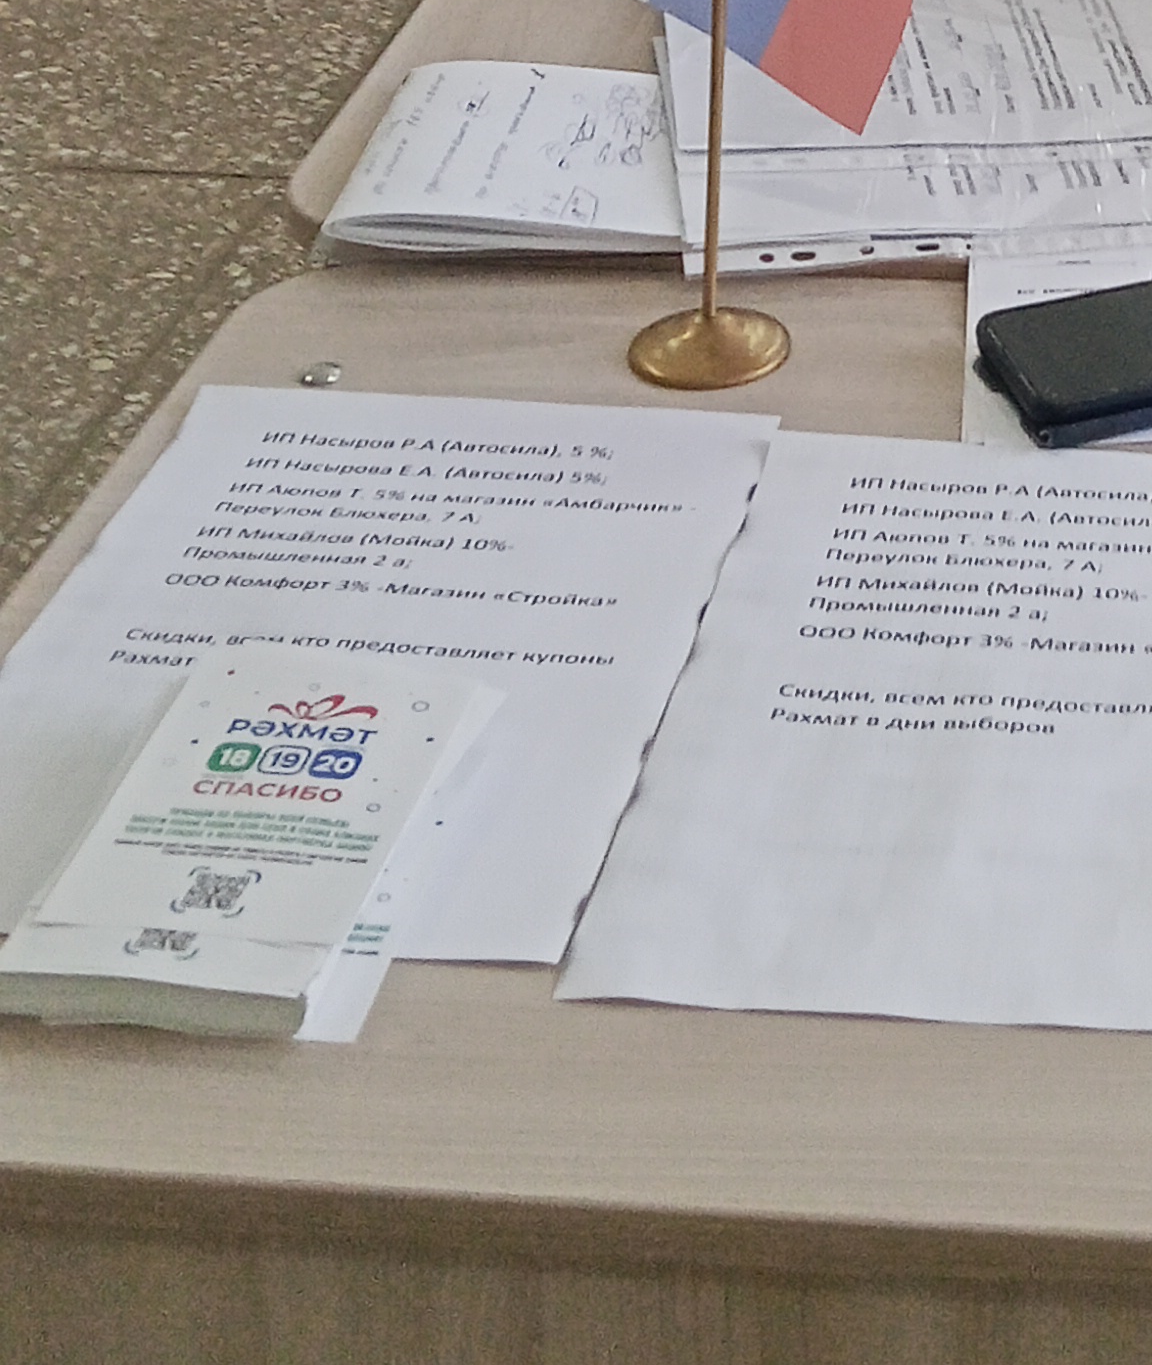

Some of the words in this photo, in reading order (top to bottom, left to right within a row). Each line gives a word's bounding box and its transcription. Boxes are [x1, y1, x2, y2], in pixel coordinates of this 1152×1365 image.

[262, 431, 296, 444] ИП
[300, 433, 395, 450] Насыров
[570, 445, 582, 458] 5
[245, 457, 280, 470] ИП
[284, 459, 393, 476] Насырова
[444, 466, 564, 484] (Автосила)
[228, 481, 263, 494] ИП
[268, 483, 341, 499] Аюпов
[374, 489, 405, 502] 5%
[410, 493, 437, 504] на
[443, 493, 536, 508] магазин
[543, 496, 683, 515] «Амбарчик»
[850, 477, 884, 490] ИП
[889, 478, 988, 495] Насыров
[214, 501, 323, 518] Переулок
[329, 506, 432, 523] Блюхера,
[441, 511, 456, 523] 7
[841, 502, 875, 516] ИП
[881, 504, 994, 521] Насырова
[196, 525, 233, 539] ИП
[236, 526, 354, 545] Михайлов
[359, 533, 455, 551] (Мойка)
[832, 527, 868, 542] ИП
[872, 530, 950, 545] Аюпов
[984, 535, 1016, 548] 5%
[1022, 539, 1050, 550] на
[1056, 540, 1152, 554] магазин
[182, 545, 367, 566] Промышленная
[372, 554, 387, 568] 2
[826, 548, 937, 566] Переулок
[944, 553, 1052, 571] Блюхера,
[1062, 558, 1075, 570] 7
[165, 573, 221, 587] ООО
[224, 575, 331, 592] Комфорт
[334, 579, 370, 594] 3%
[493, 591, 618, 608] «Стройка»
[816, 575, 852, 589] ИП
[857, 577, 980, 593] Михайлов
[986, 581, 1084, 601] (Мойка)
[808, 596, 1001, 619] Промышленная
[1007, 605, 1021, 619] 2
[126, 627, 216, 647] Скидки,
[291, 636, 331, 648] кто
[336, 639, 516, 663] предоставляет
[522, 650, 614, 666] купоны
[798, 625, 856, 640] ООО
[862, 627, 973, 648] Комфорт
[979, 634, 1014, 649] 3%
[108, 649, 198, 668] Рахмат
[778, 683, 876, 704] Скидки,
[884, 692, 946, 706] всем
[952, 694, 994, 706] кто
[227, 718, 378, 745] РӘХМӘТ
[770, 707, 859, 727] Рахмат
[866, 715, 879, 727] в
[885, 716, 936, 731] дни
[943, 716, 1055, 734] выборов
[217, 747, 248, 767] 18
[268, 750, 302, 769] 19
[312, 754, 354, 775] 20
[192, 780, 343, 803] СПАСИБО
